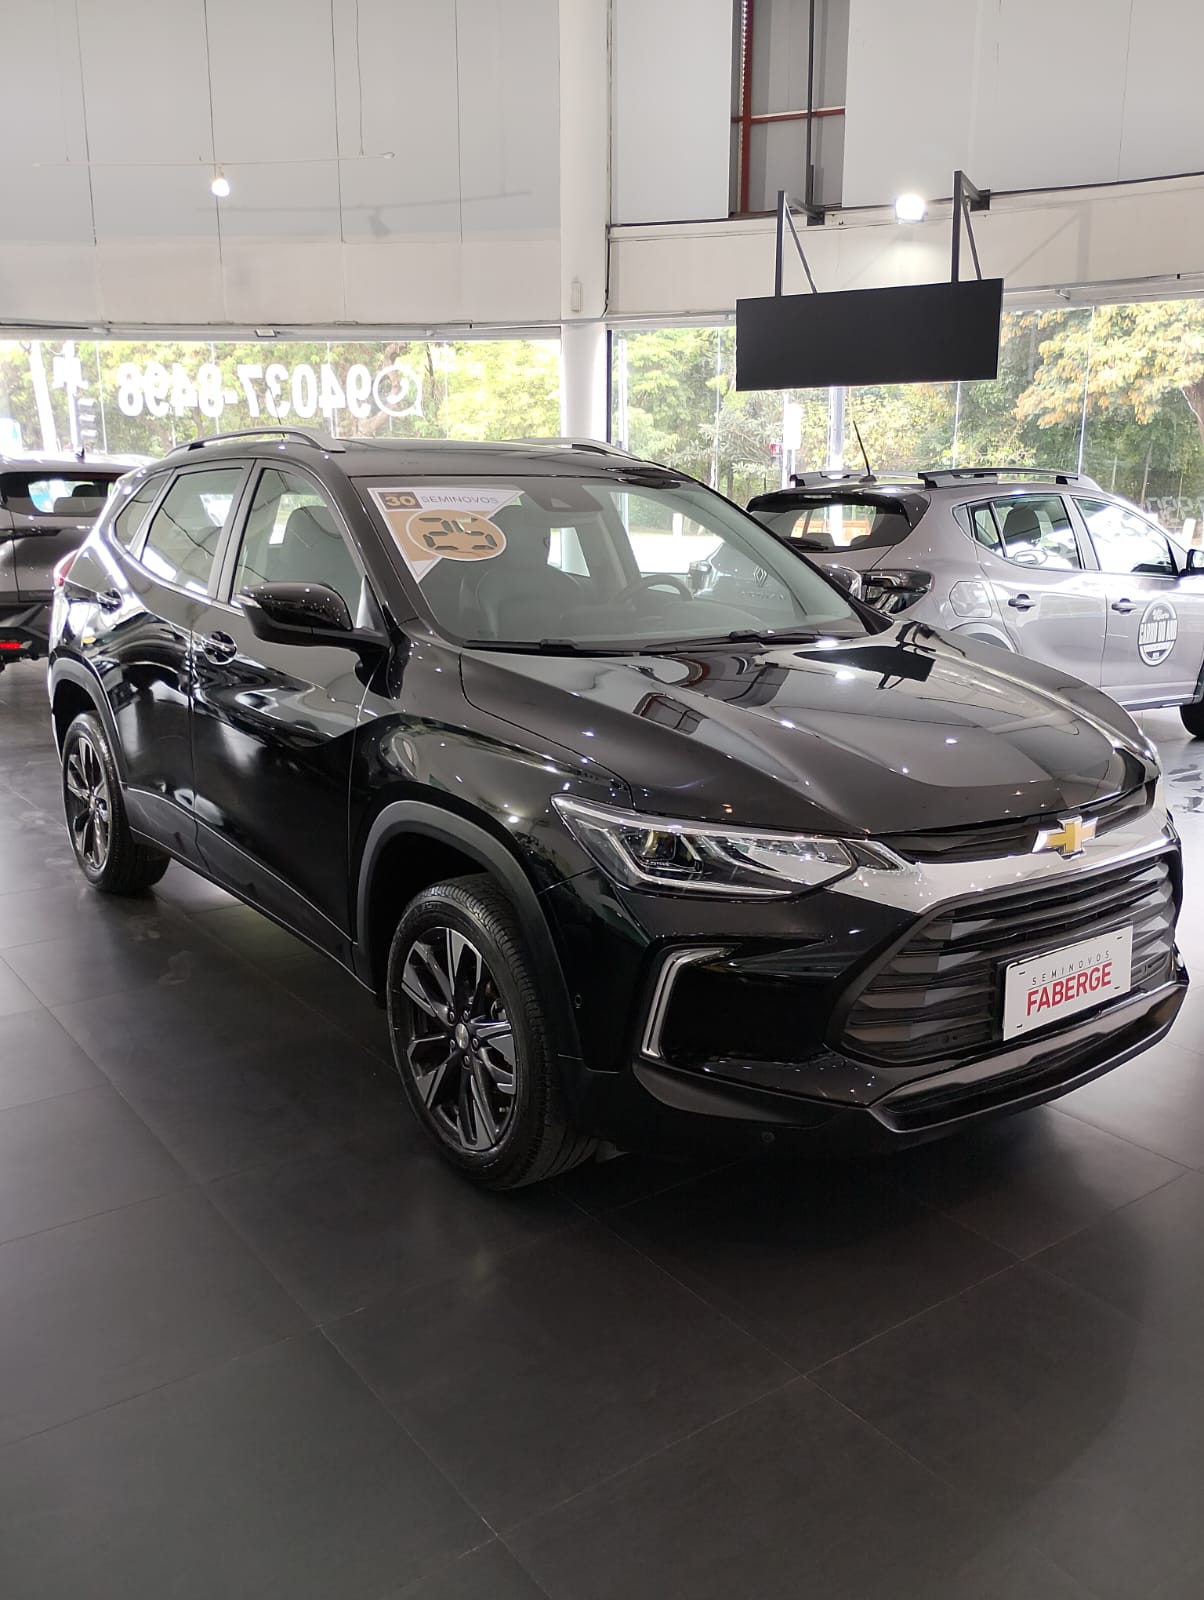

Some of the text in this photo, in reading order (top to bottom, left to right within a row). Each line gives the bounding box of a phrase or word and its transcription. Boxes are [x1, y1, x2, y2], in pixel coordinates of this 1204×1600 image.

[384, 495, 498, 506] 30 SEMINOVOS
[1032, 950, 1110, 985] SEMINOVOS
[1026, 962, 1112, 1016] FABERGE
